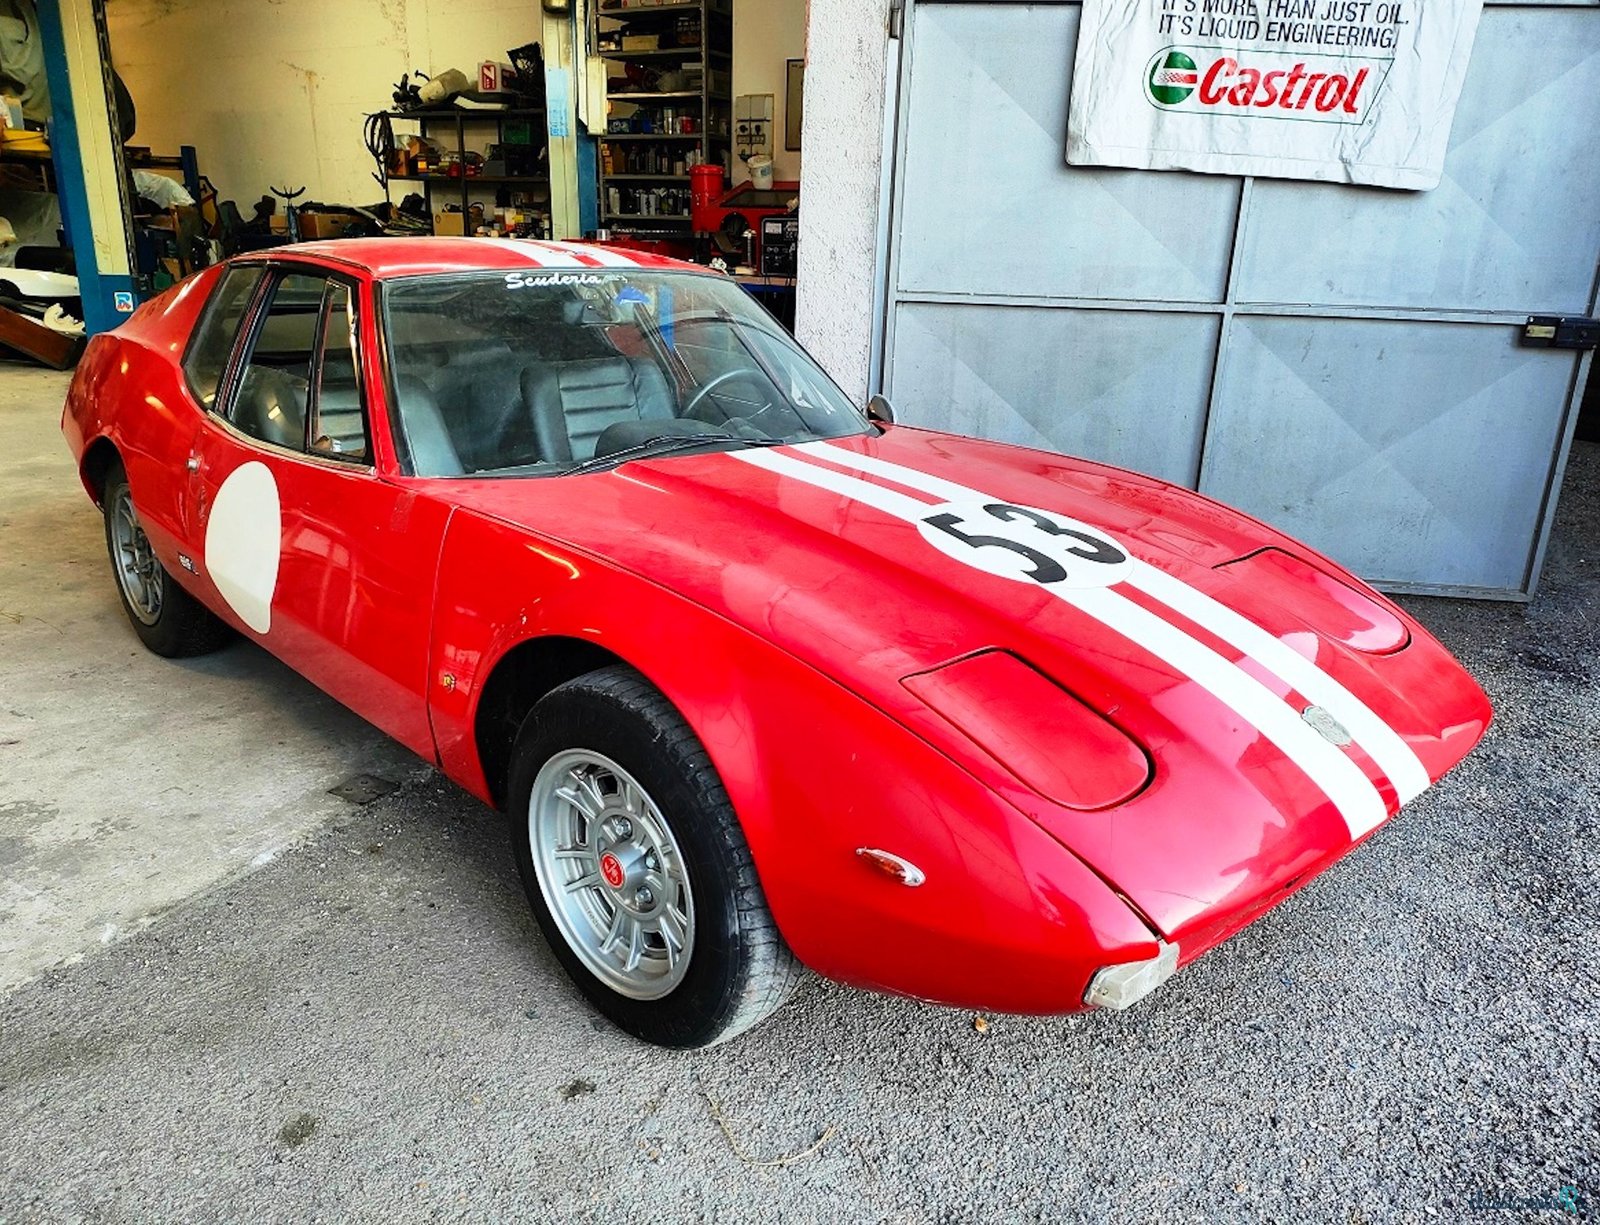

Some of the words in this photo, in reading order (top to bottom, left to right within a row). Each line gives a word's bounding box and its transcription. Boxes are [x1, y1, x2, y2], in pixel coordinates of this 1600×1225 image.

[1202, 0, 1258, 17] MORE
[1266, 0, 1316, 19] THAN
[1320, 1, 1371, 22] JUST
[1376, 3, 1409, 25] OIL.
[1158, 14, 1194, 35] IT'S
[1198, 16, 1260, 40] LIQUID
[1264, 21, 1397, 49] ENGINEERING.
[1199, 57, 1370, 114] Castrol
[505, 272, 602, 289] Scuderia
[920, 503, 1127, 584] 53
